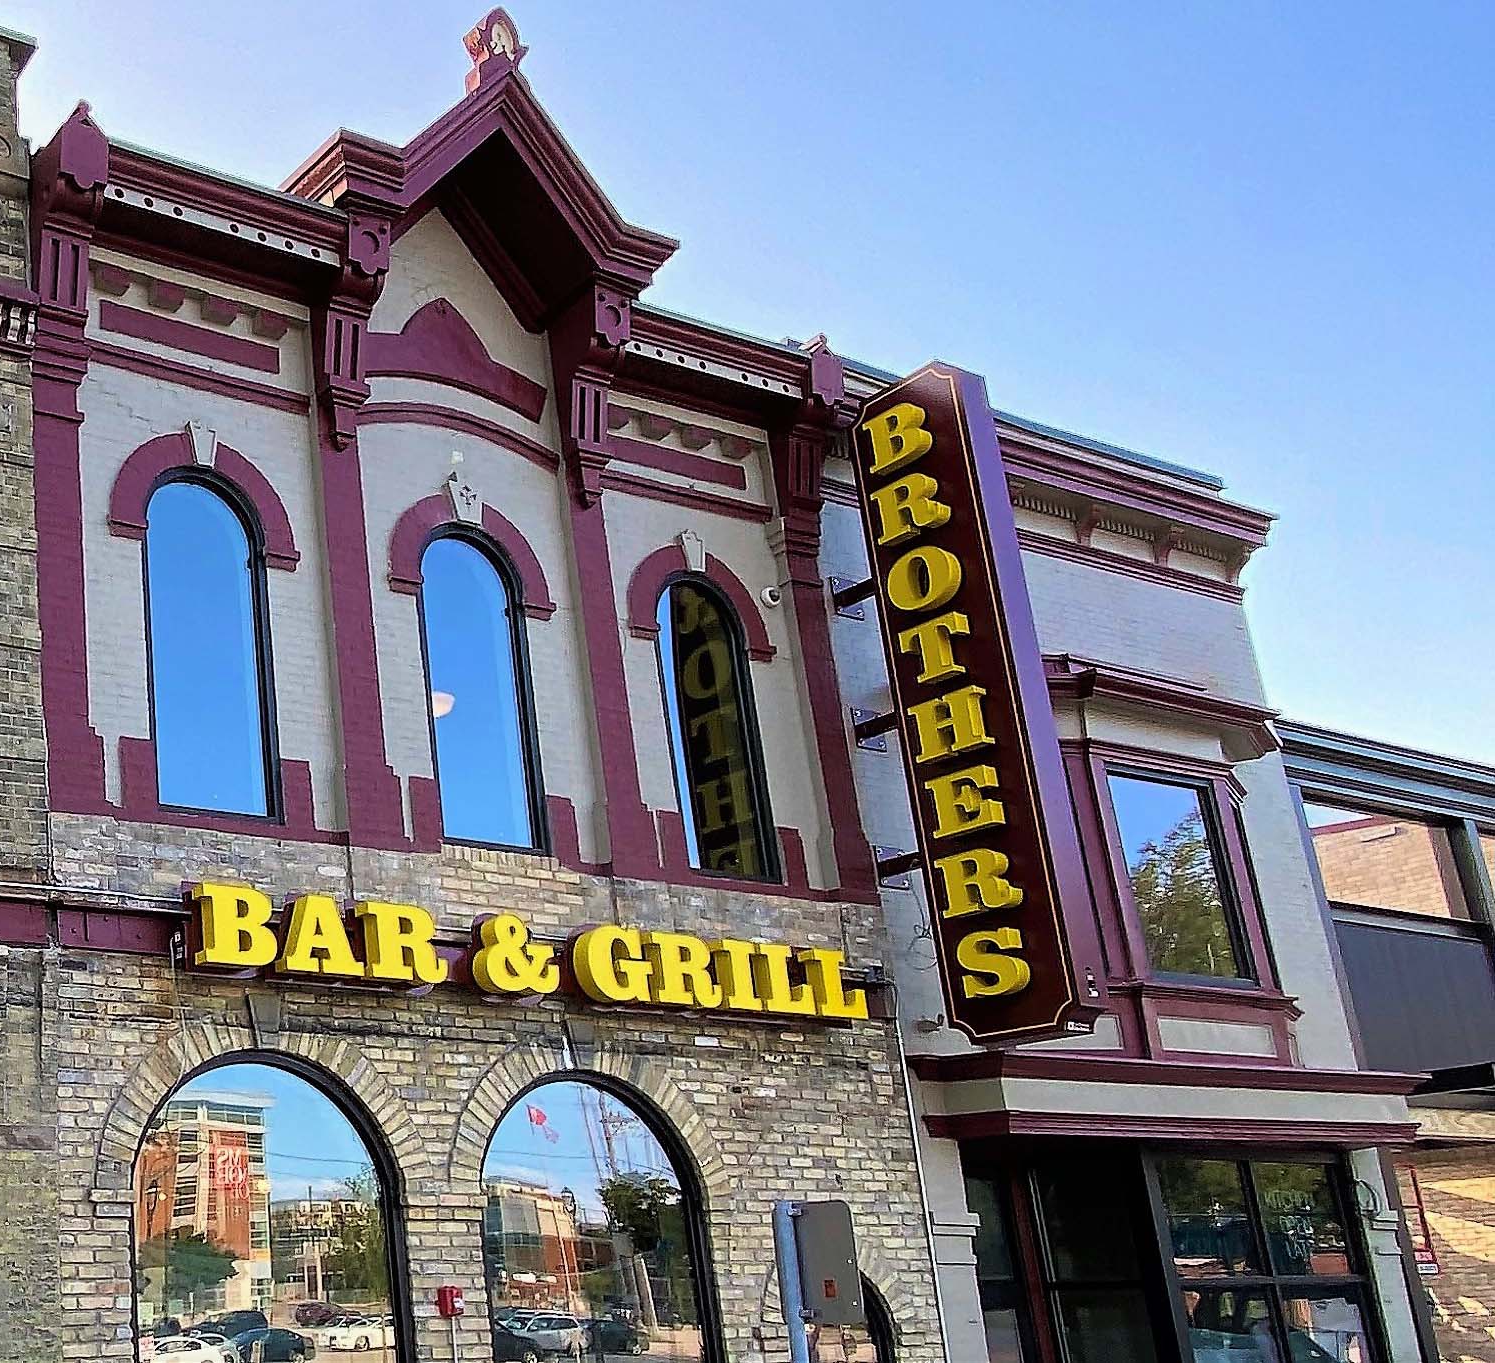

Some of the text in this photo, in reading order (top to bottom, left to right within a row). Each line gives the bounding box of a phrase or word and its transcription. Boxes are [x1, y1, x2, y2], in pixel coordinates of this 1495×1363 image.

[861, 402, 1030, 998] BROTHERS
[195, 882, 869, 1020] BAR & GRILL
